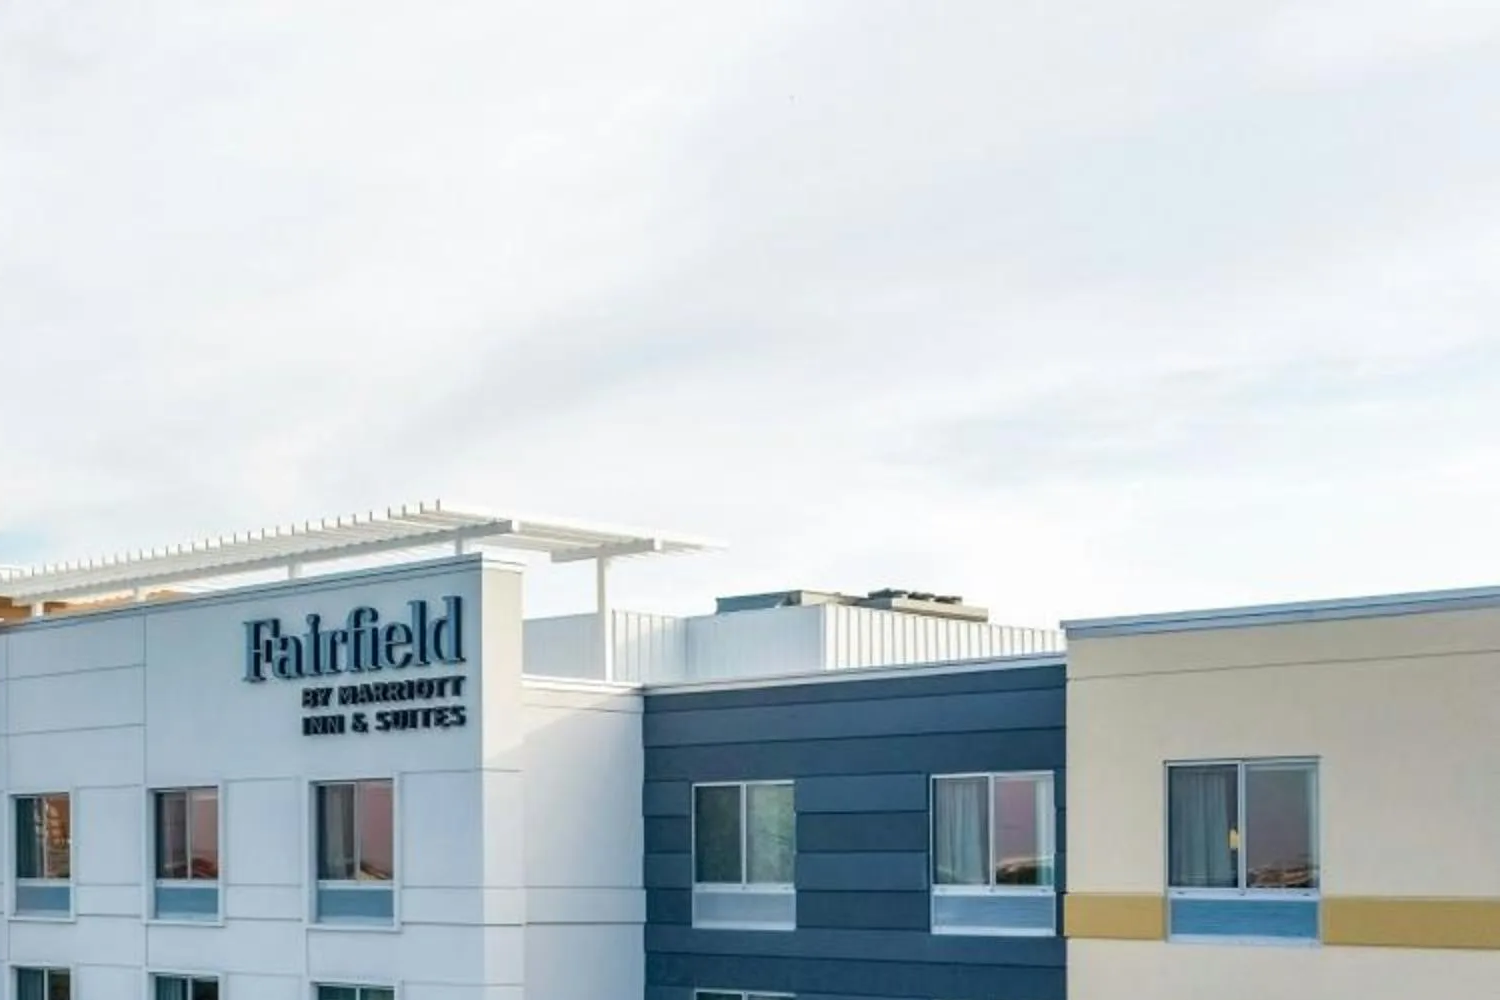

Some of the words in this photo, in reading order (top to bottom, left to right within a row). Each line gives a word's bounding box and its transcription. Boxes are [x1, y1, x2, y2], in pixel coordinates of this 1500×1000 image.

[242, 595, 466, 683] Fairfield
[301, 687, 334, 708] BY
[338, 675, 466, 705] MARRIOTT
[302, 714, 345, 736] INN
[351, 711, 368, 733] &
[375, 705, 466, 731] SUITES
